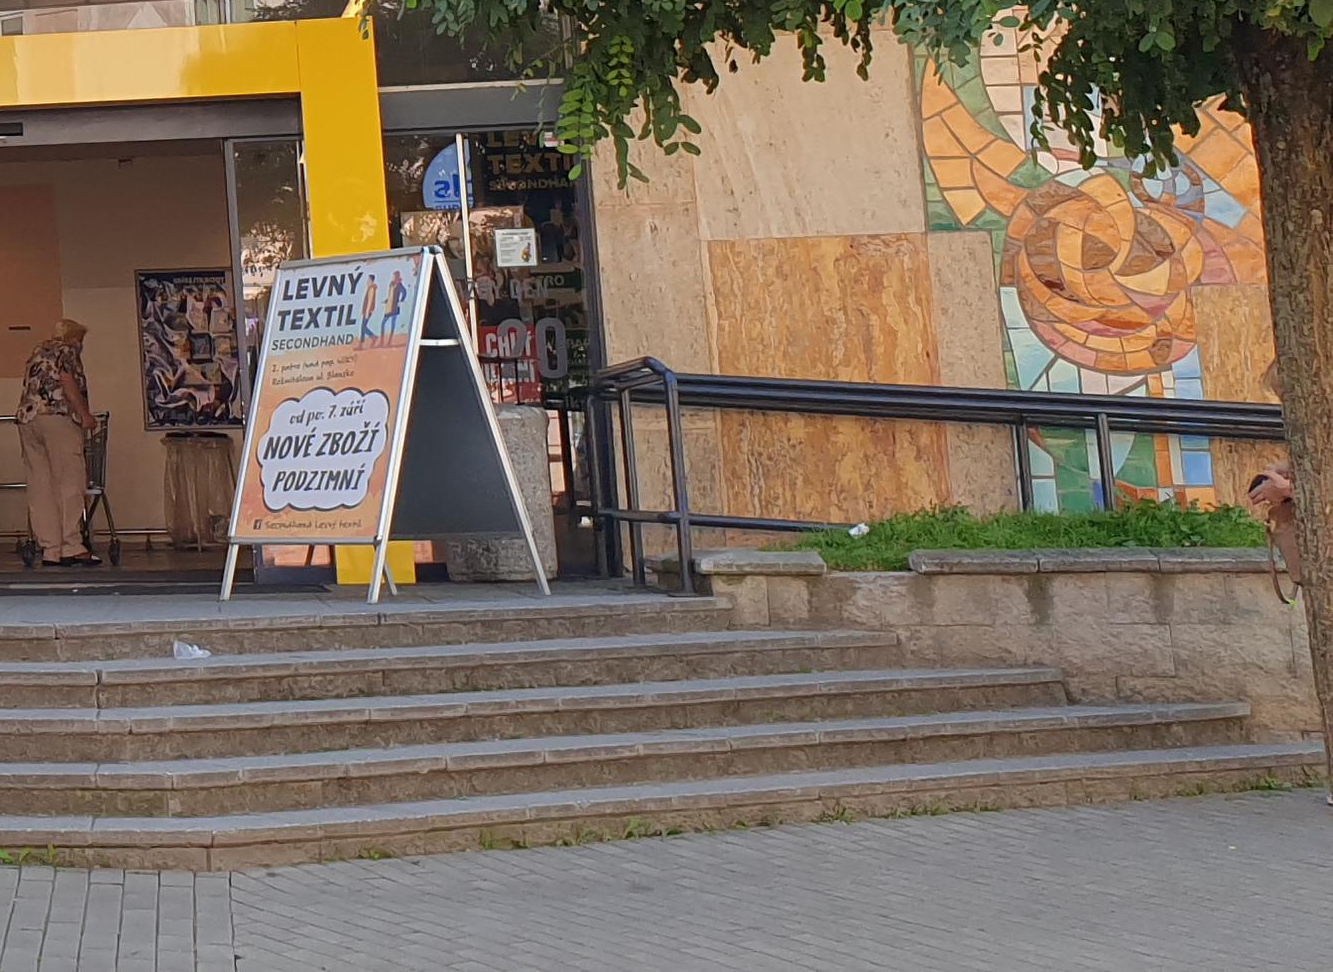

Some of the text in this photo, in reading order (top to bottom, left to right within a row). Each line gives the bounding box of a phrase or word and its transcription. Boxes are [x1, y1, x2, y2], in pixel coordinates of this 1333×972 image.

[486, 152, 571, 175] TEXTI
[282, 265, 364, 302] LEVNÝ
[277, 303, 357, 332] TEXTIL
[271, 333, 355, 351] SECONDHAND
[289, 399, 367, 427] od po. 7. září
[262, 421, 381, 461] NOVÉ ZBOŽÍ
[271, 463, 366, 492] PODZIMNÍ
